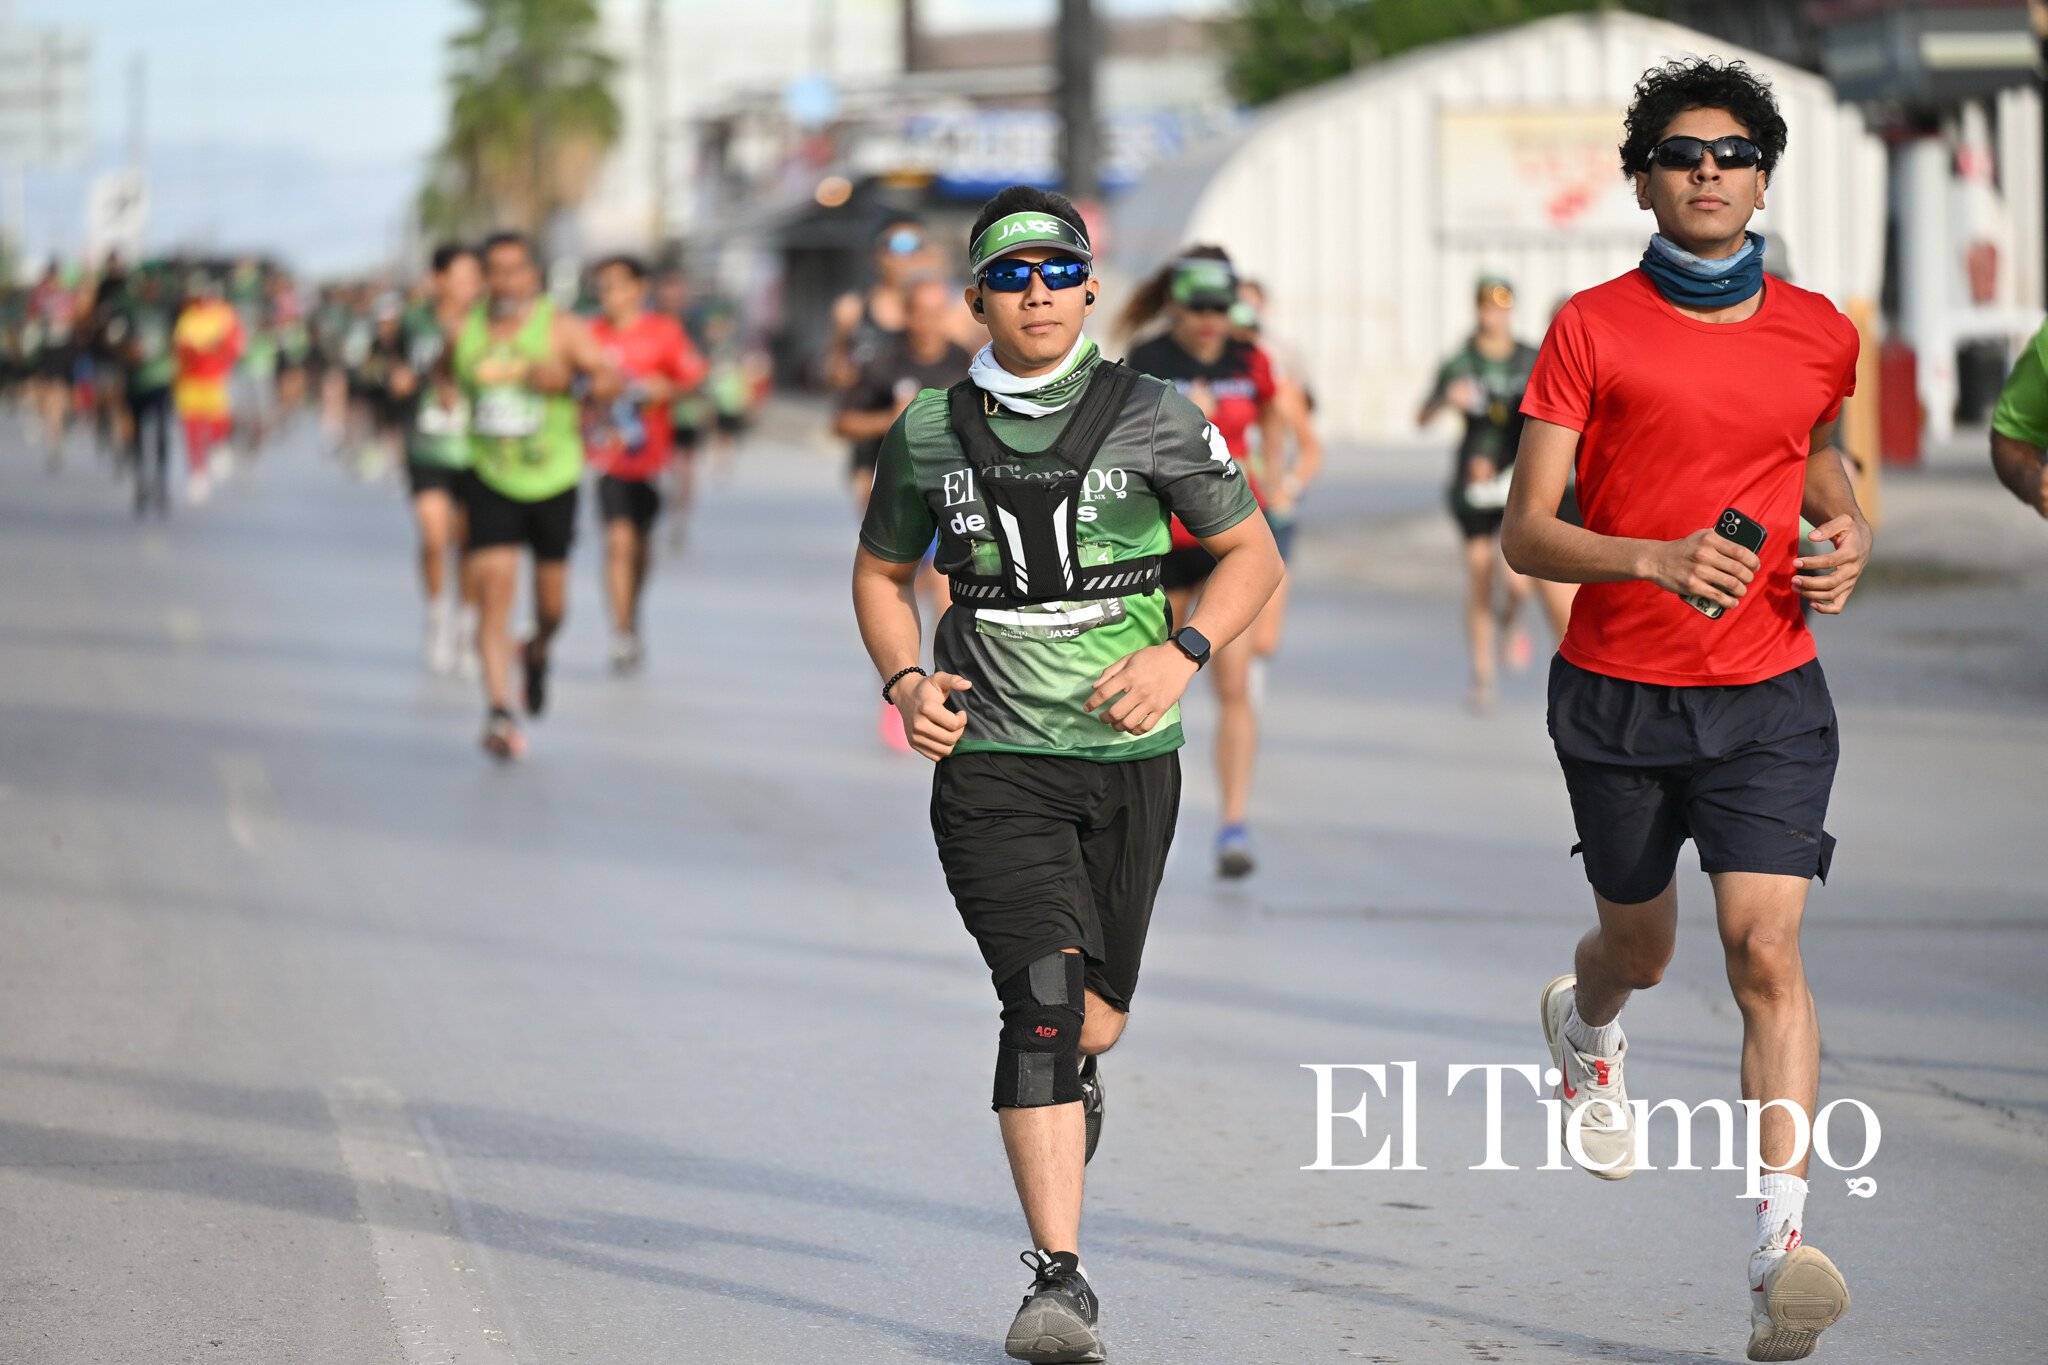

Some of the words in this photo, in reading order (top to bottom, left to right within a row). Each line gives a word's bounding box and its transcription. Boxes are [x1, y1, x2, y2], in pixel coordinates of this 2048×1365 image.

[941, 467, 977, 508] El
[950, 511, 986, 535] de
[1035, 1025, 1059, 1037] ACE
